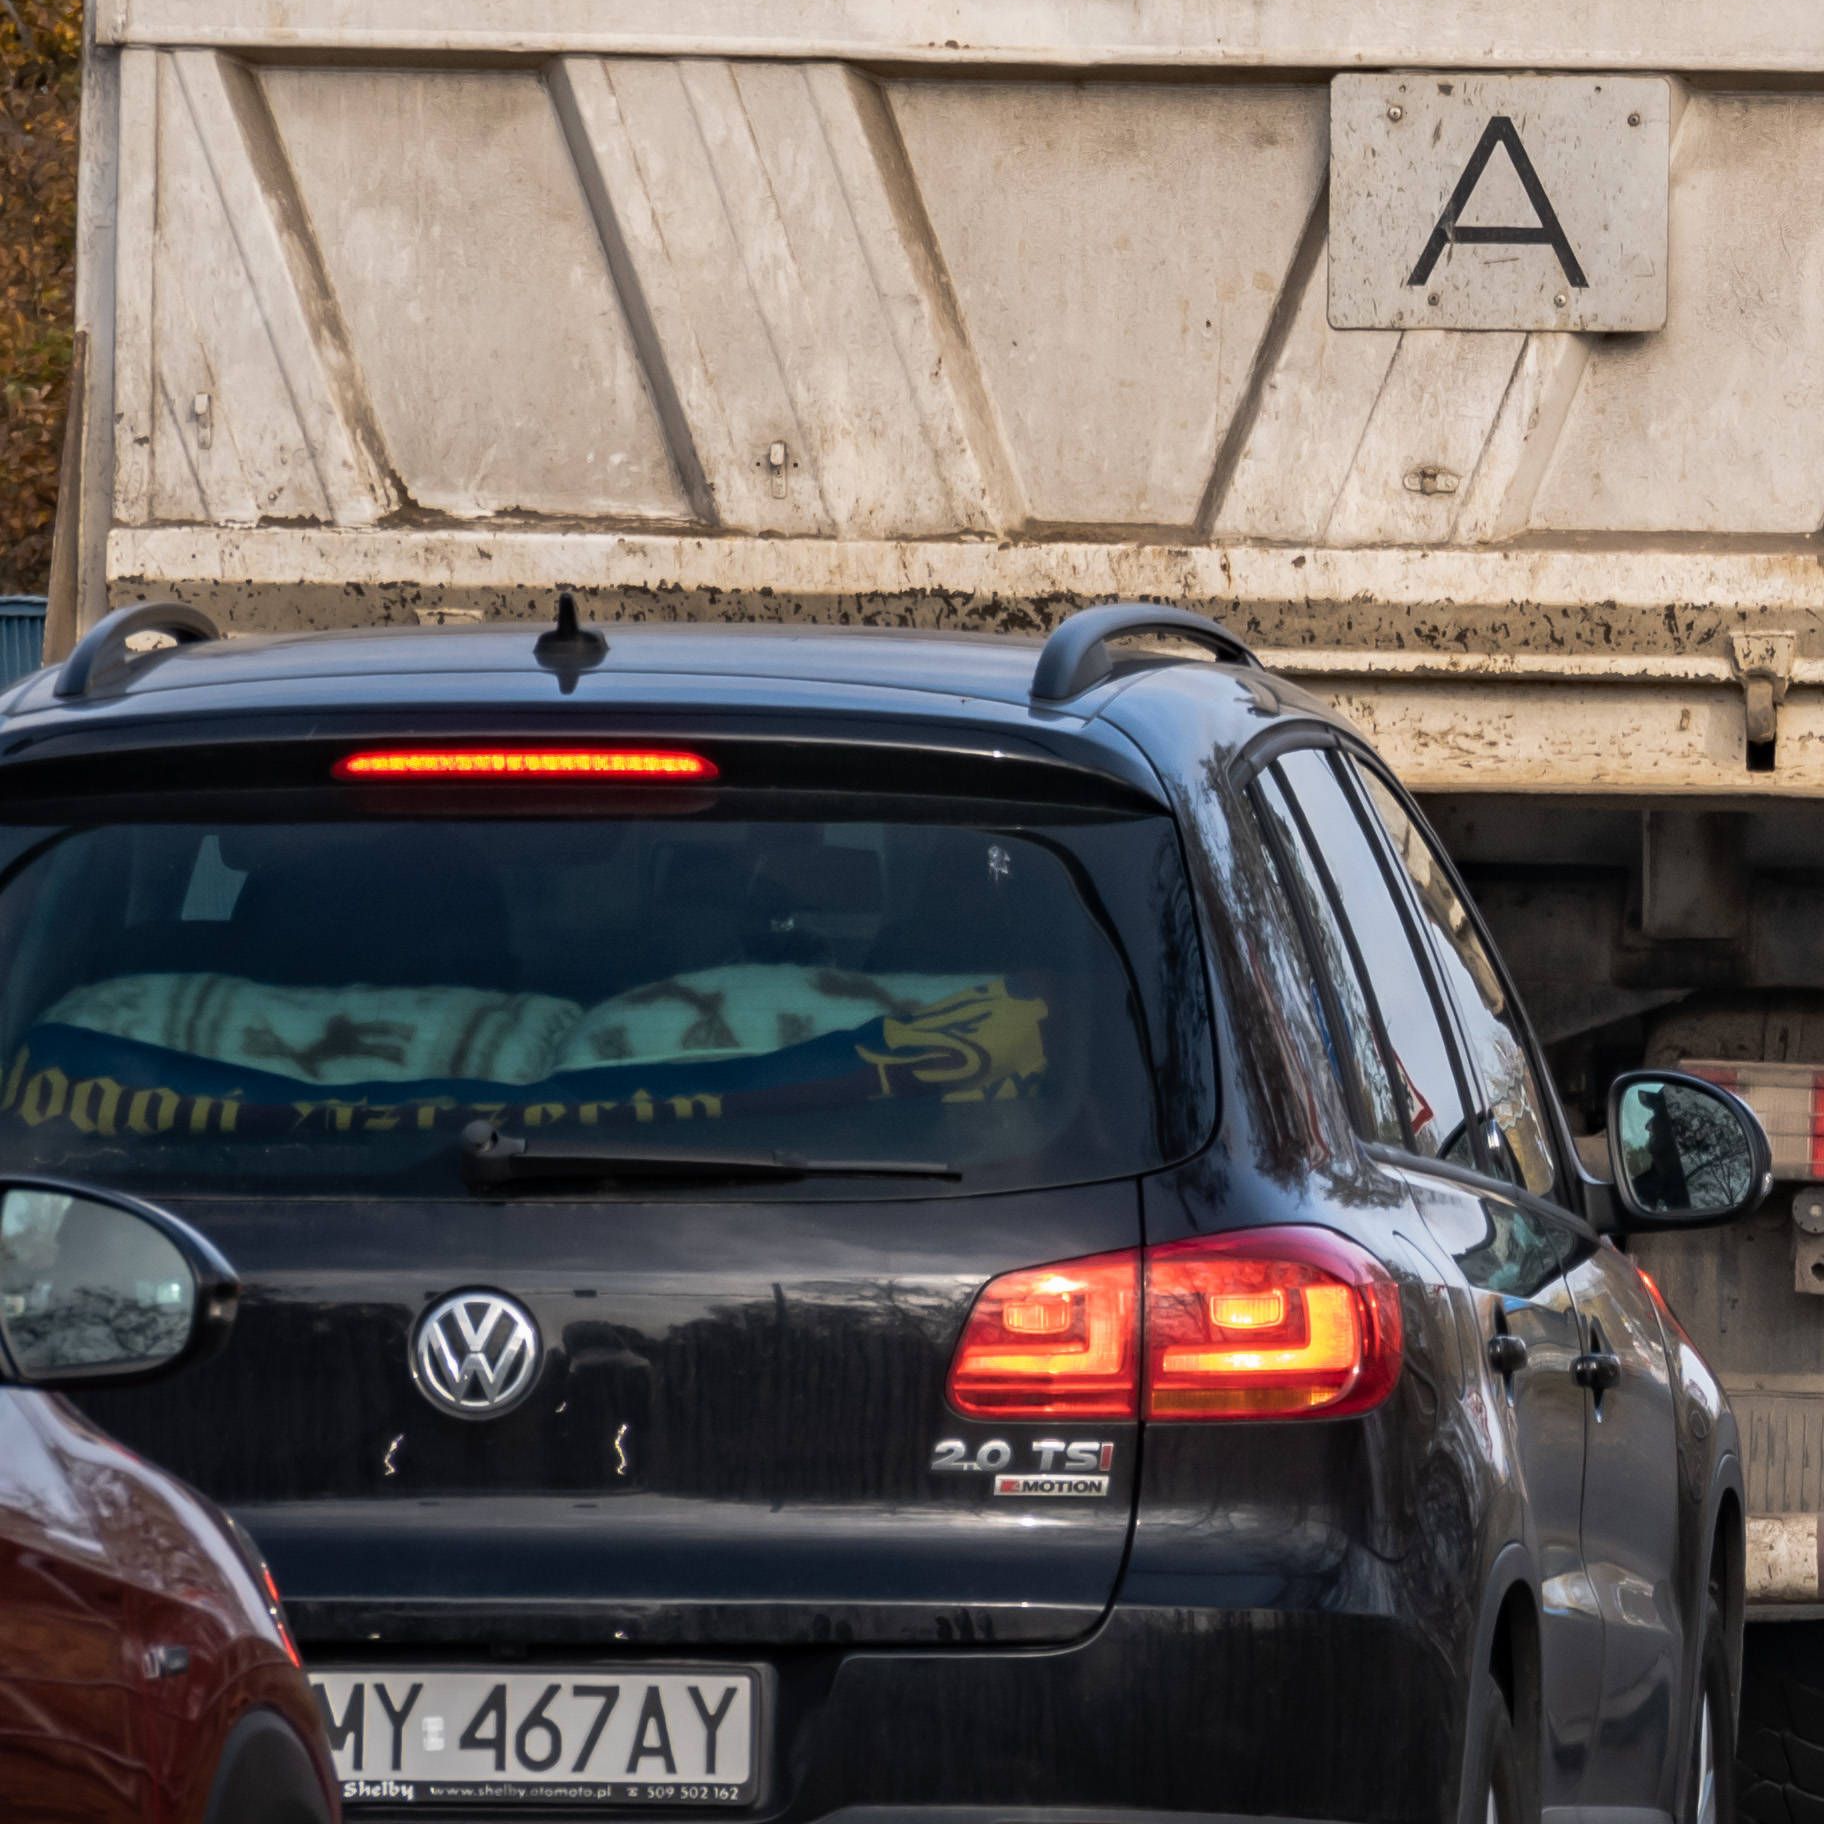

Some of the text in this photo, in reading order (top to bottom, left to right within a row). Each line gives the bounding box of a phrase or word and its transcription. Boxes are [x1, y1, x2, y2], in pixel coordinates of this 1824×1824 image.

[1407, 116, 1589, 288] A
[931, 1439, 1114, 1471] 2.0 TSI
[459, 1683, 739, 1775] 467AY
[343, 1780, 414, 1801] Shelby
[647, 1786, 675, 1800] 509
[680, 1787, 708, 1801] 502
[713, 1788, 739, 1801] 162
